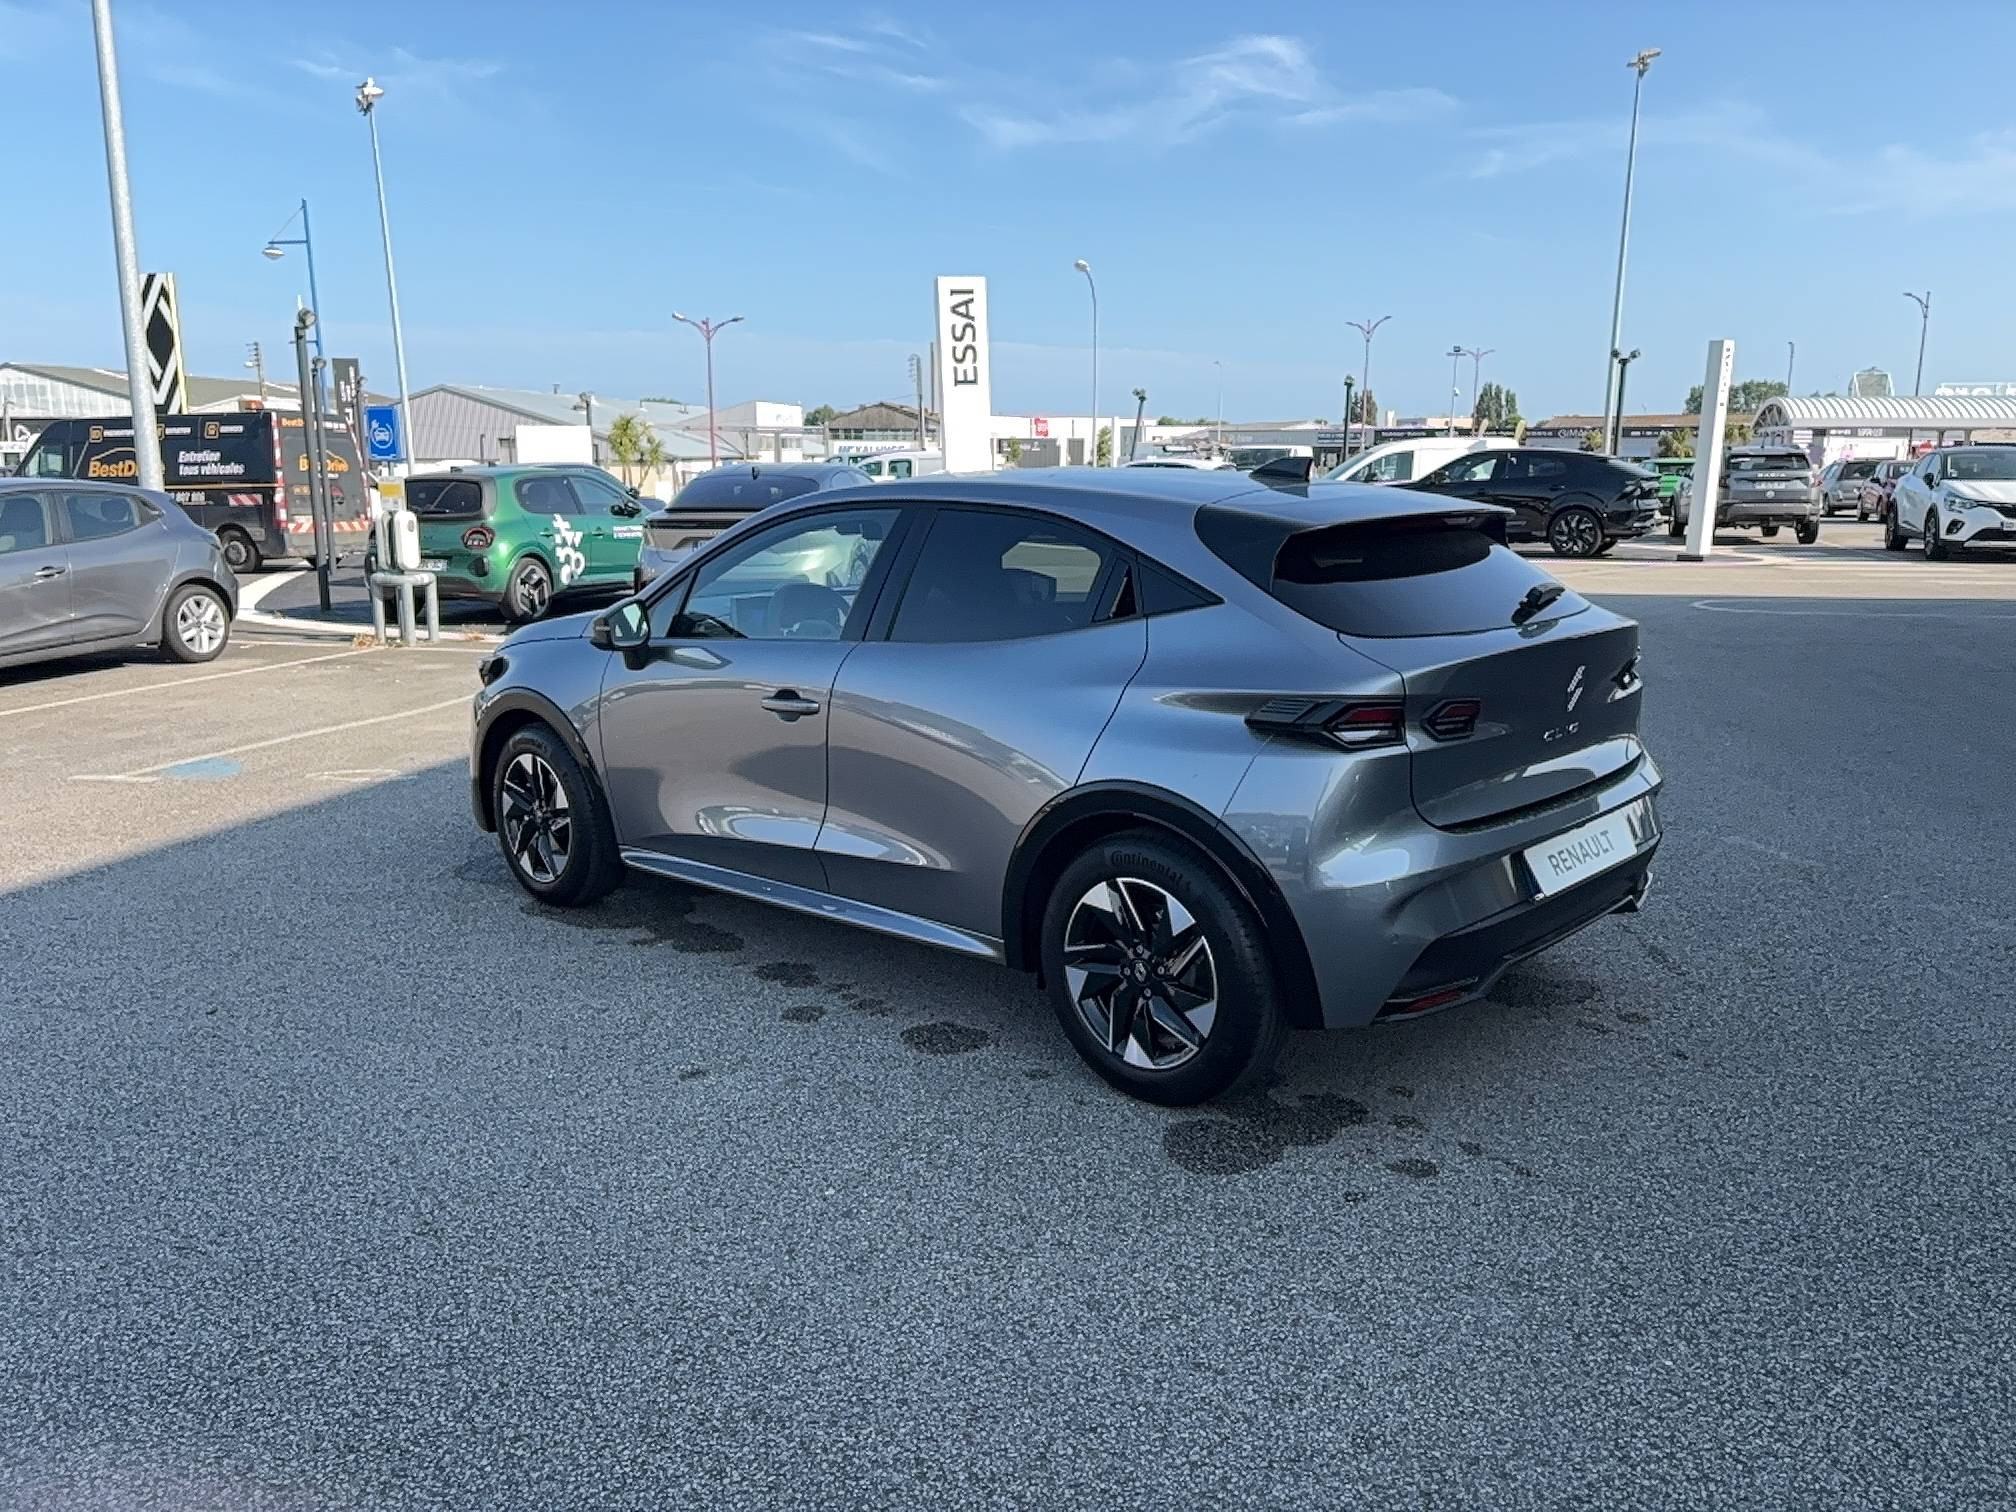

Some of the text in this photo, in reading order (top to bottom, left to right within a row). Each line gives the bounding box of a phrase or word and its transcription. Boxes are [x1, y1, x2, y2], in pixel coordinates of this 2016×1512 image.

[950, 288, 978, 387] ESSAI
[178, 450, 221, 463] Entretien
[179, 461, 246, 476] tous véhicules
[1111, 849, 1184, 882] Continental
[1547, 829, 1615, 876] RENAULT
